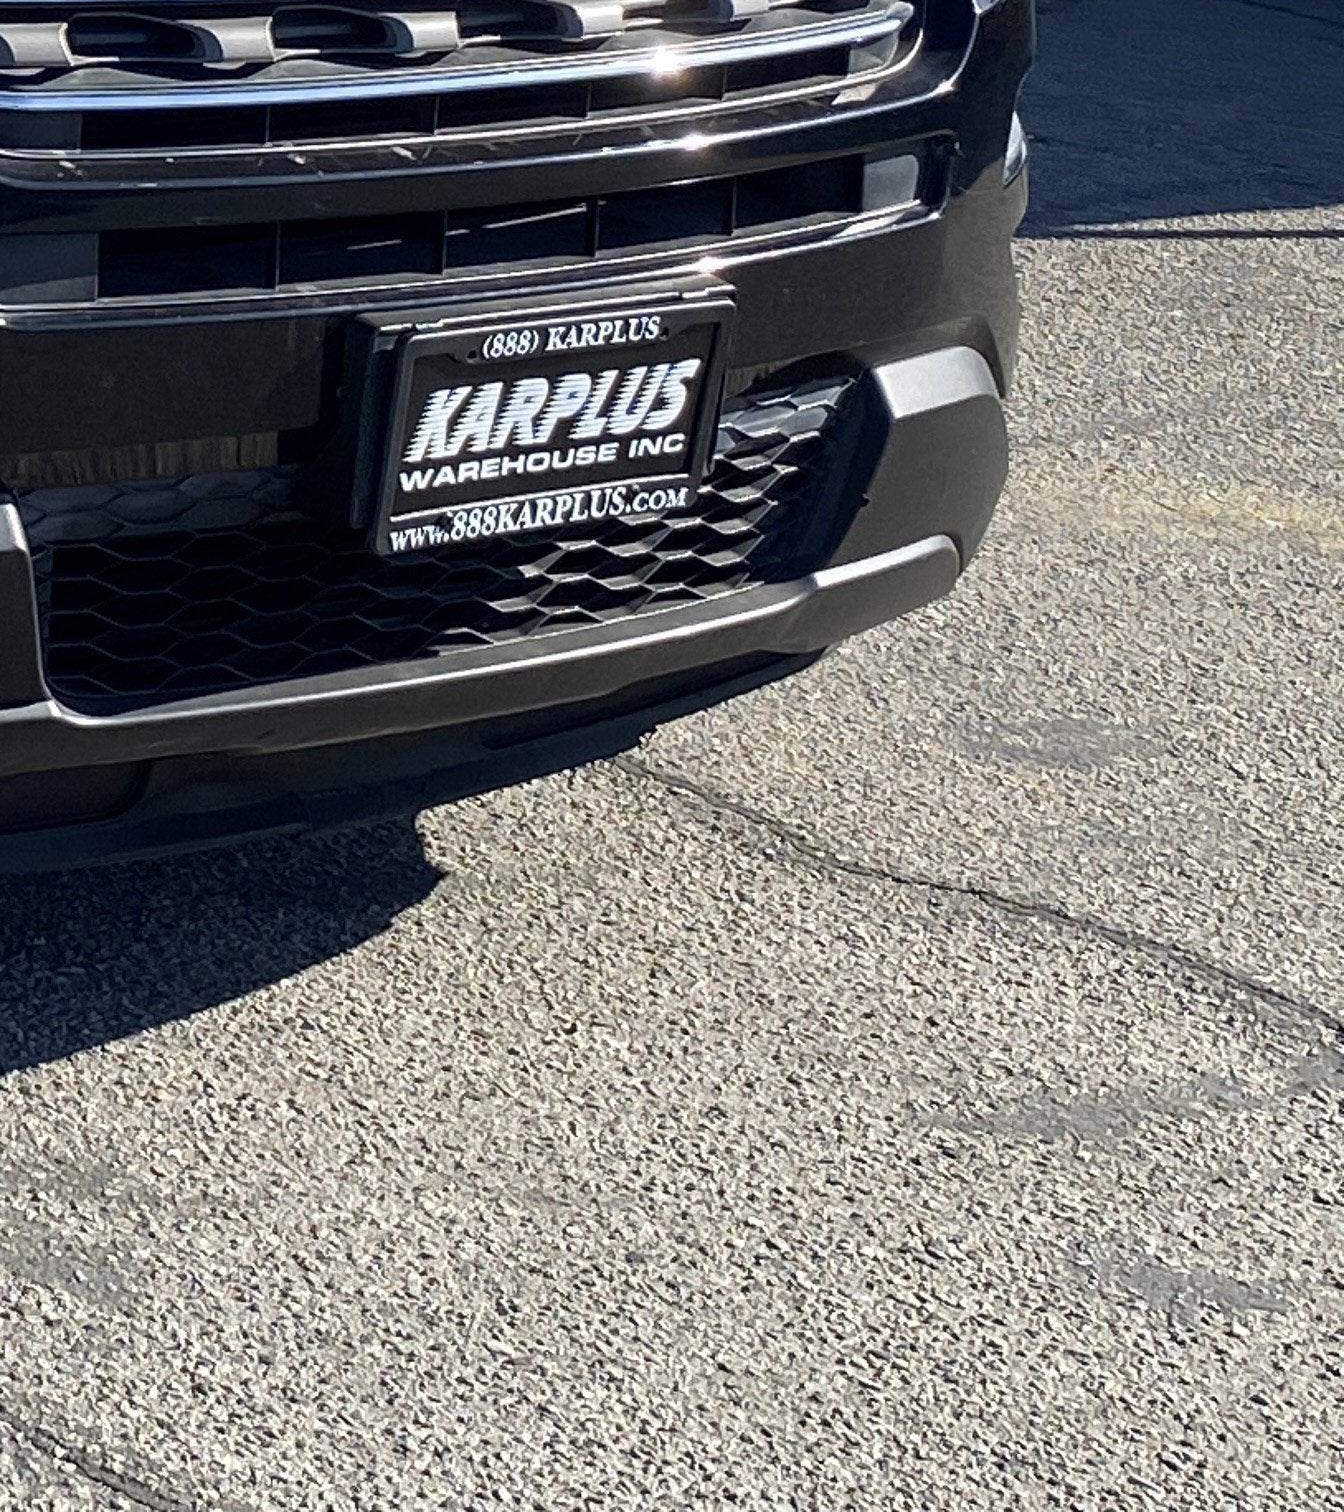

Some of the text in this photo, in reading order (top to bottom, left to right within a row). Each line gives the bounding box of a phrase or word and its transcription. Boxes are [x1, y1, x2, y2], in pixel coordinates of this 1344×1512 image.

[482, 315, 661, 360] (888) KARPLUS
[401, 356, 702, 463] KARPLUS
[398, 432, 686, 492] WAREHOUSE INC
